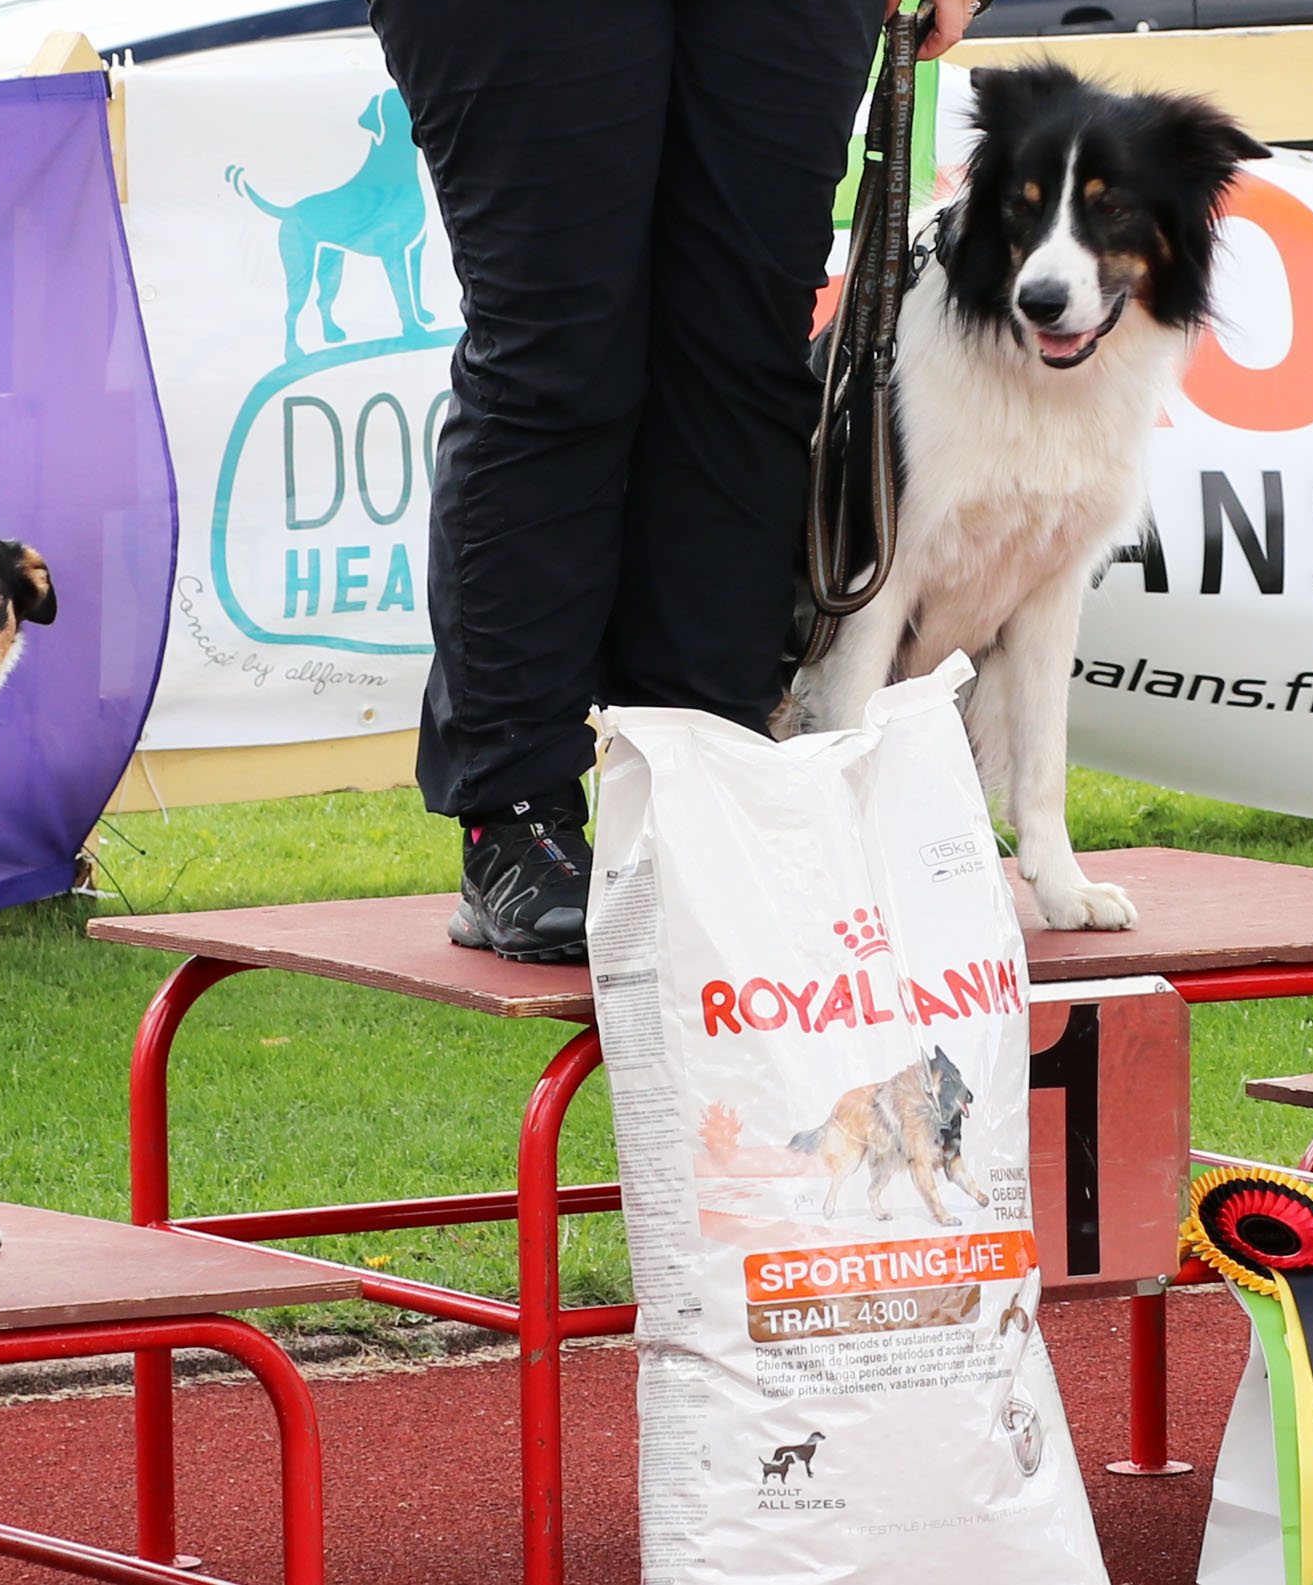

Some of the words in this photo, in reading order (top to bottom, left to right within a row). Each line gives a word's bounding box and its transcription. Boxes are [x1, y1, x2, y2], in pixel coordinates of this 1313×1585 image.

[283, 543, 426, 618] HEA
[242, 653, 274, 688] by
[930, 840, 976, 859] 15kg
[700, 969, 894, 1037] ROYAL
[896, 958, 1023, 1024] ANIN
[1029, 1004, 1100, 1277] 1
[760, 1247, 947, 1294] SPORTING
[955, 1241, 1006, 1275] LIFE
[763, 1304, 849, 1336] TRAIL
[856, 1297, 918, 1326] 4300
[756, 1347, 782, 1360] Dogs
[785, 1345, 807, 1356] with
[810, 1343, 835, 1356] long
[838, 1339, 879, 1354] periods
[882, 1336, 894, 1348] of
[895, 1332, 944, 1347] sustained
[945, 1329, 976, 1343] activity
[756, 1358, 793, 1371] Chiens
[796, 1357, 826, 1371] ayant
[829, 1355, 842, 1367] de
[845, 1353, 888, 1368] longues
[891, 1347, 934, 1364] périodes
[756, 1373, 796, 1386] Hundar
[799, 1370, 823, 1383] med
[825, 1367, 856, 1384] långa
[858, 1363, 902, 1381] perioder
[905, 1364, 917, 1375] av
[890, 1374, 938, 1390] vaativaan
[757, 1488, 802, 1497] ADULT
[757, 1499, 791, 1510] ALL
[794, 1498, 846, 1509] SIZES
[923, 1516, 974, 1529] HEALTH
